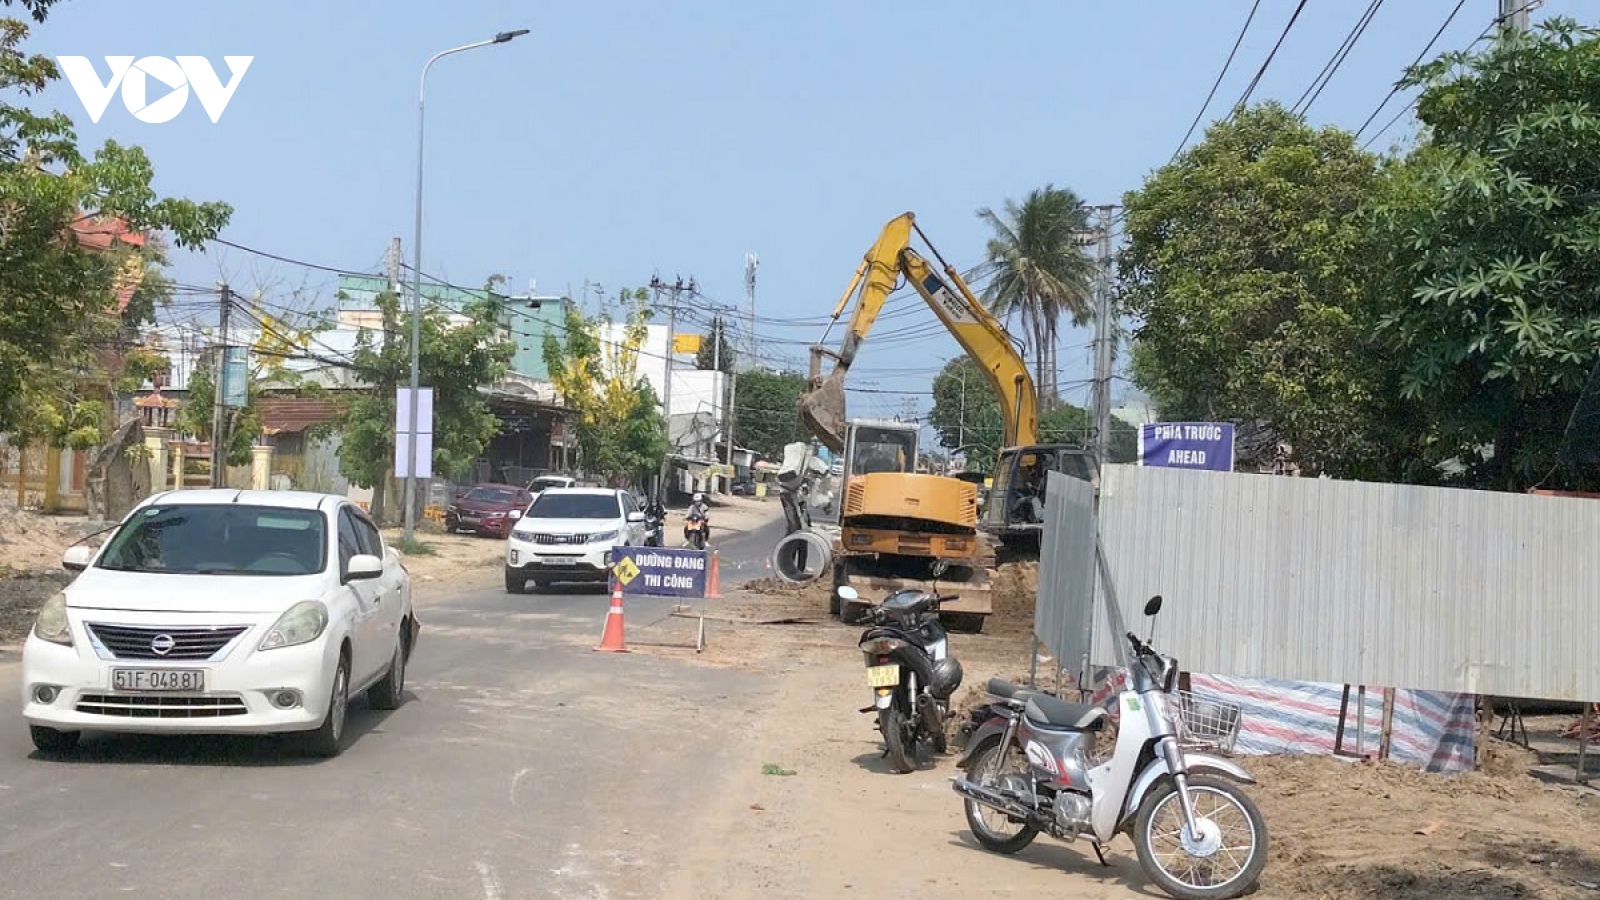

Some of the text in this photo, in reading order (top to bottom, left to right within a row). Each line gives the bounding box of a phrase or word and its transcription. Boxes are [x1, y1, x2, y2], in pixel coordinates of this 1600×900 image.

[1168, 450, 1206, 464] AHEAD
[675, 557, 706, 570] ĐANG
[644, 574, 693, 588] THI CÔNG
